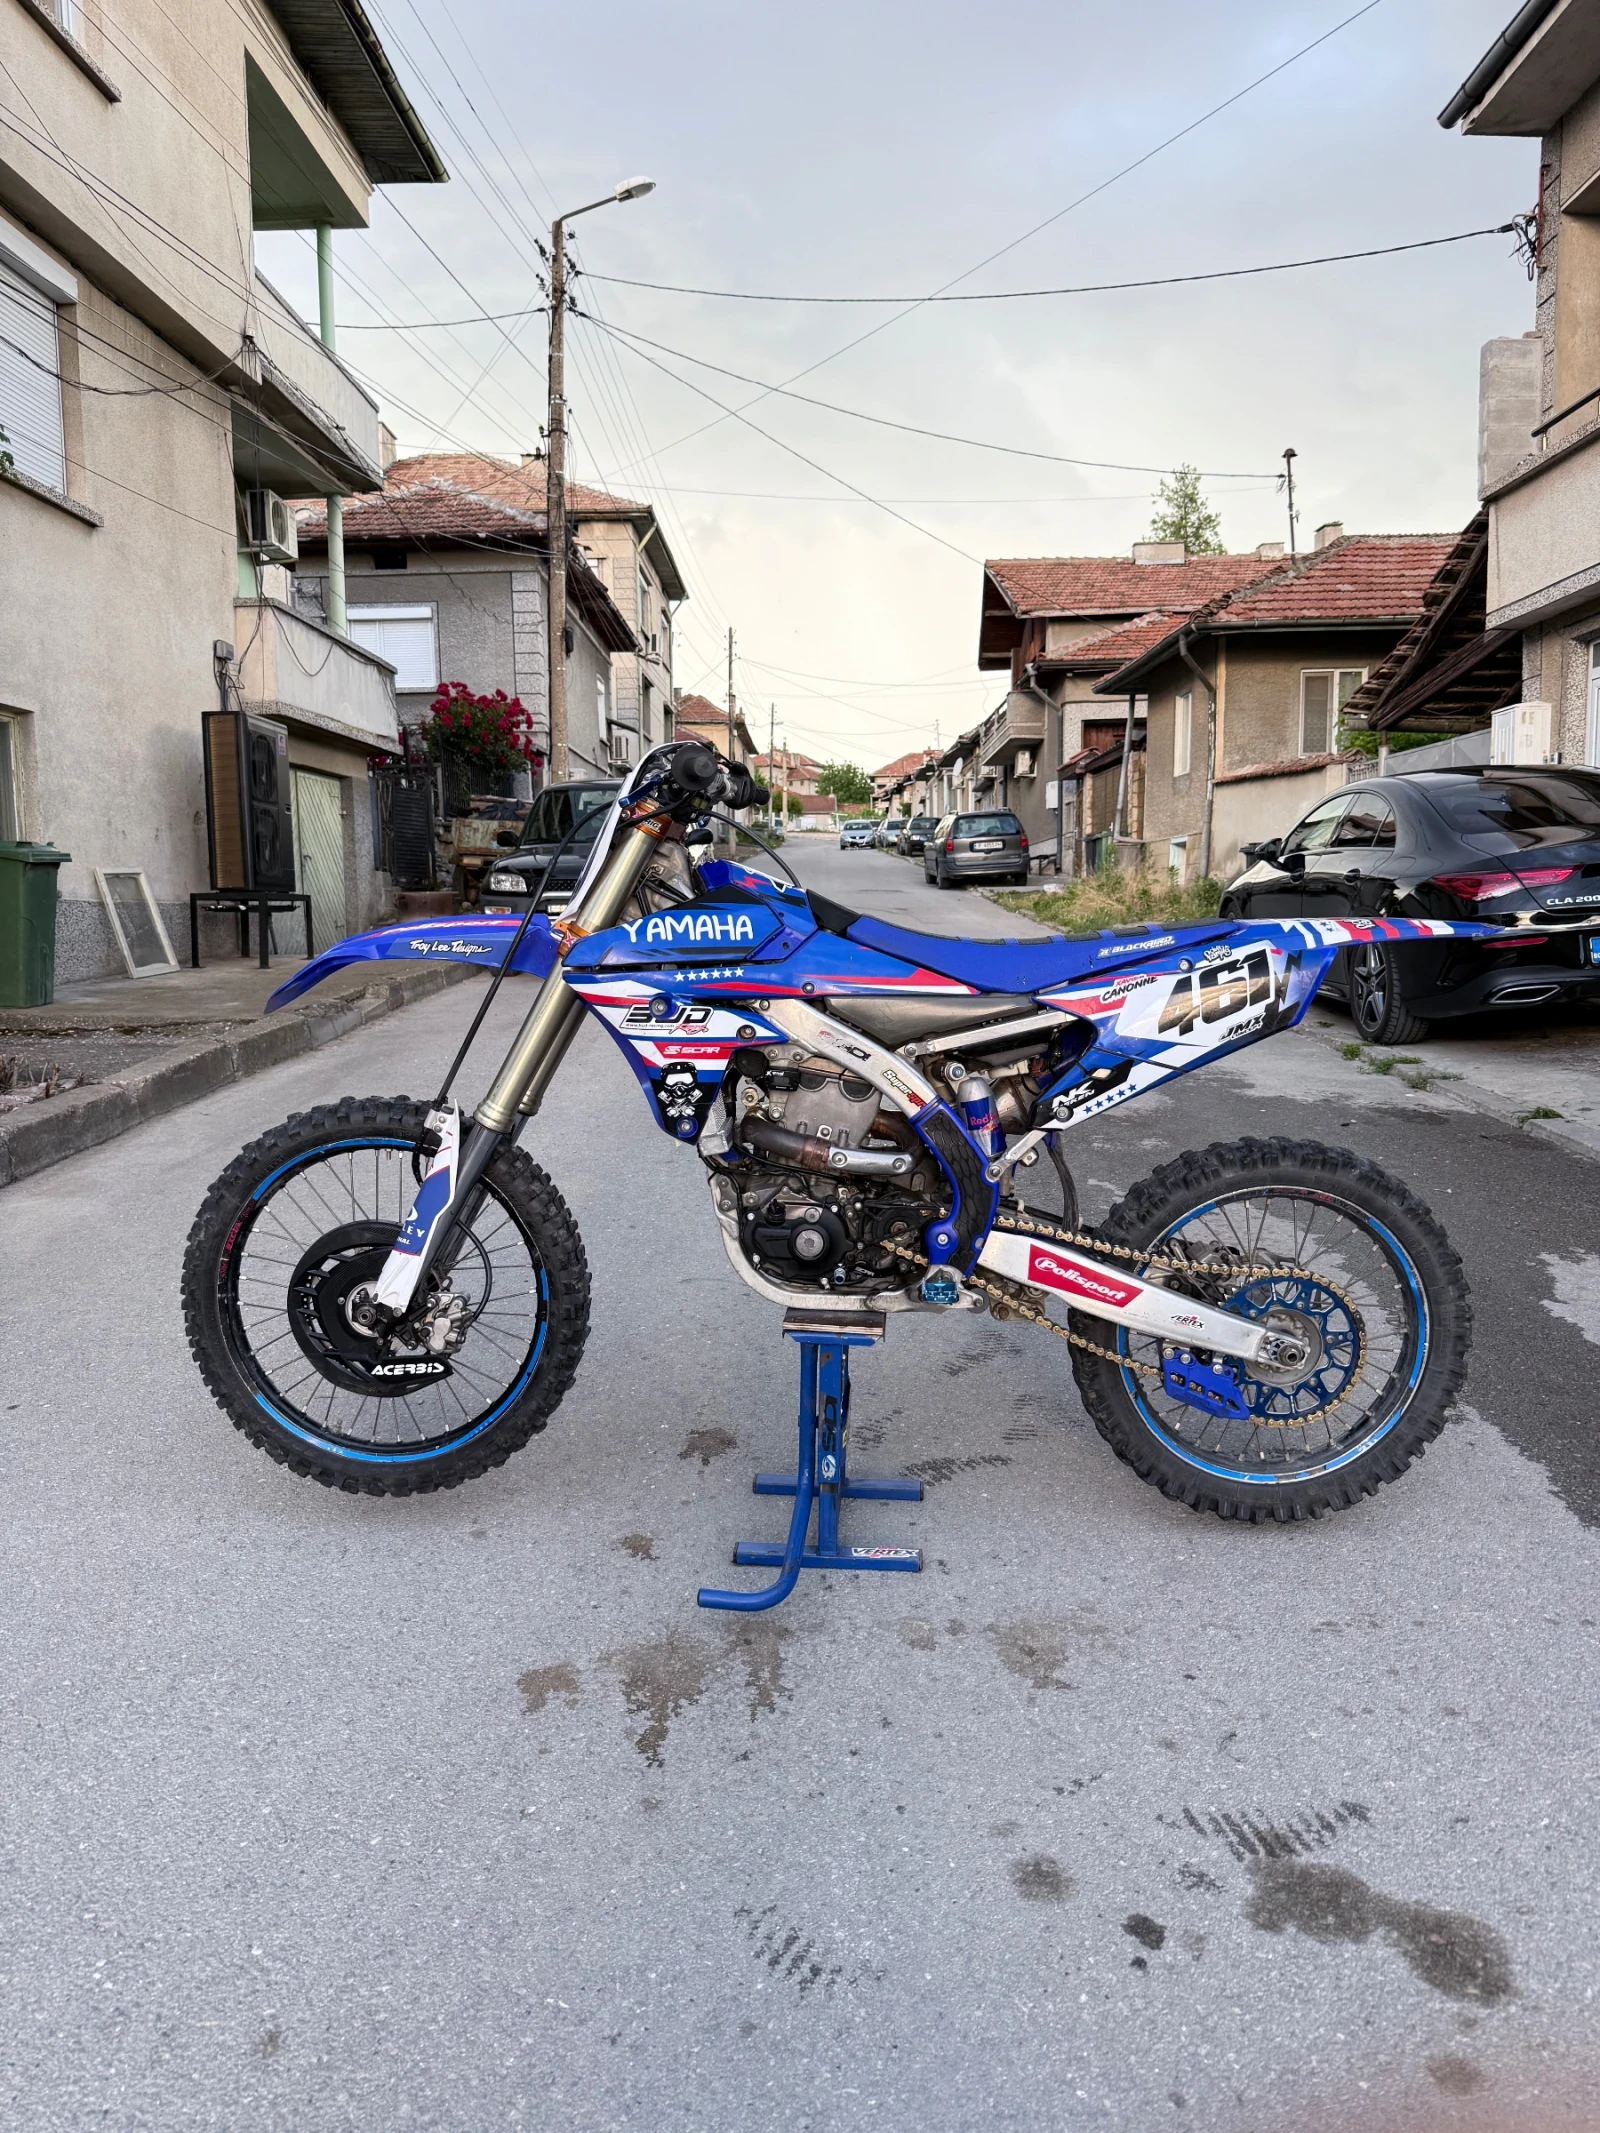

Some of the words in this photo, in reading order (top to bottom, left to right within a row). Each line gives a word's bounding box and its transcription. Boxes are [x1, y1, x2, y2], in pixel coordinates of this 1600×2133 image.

[1576, 895, 1600, 903] 200
[622, 914, 754, 943] YAMAHA
[409, 939, 430, 955] Troy
[431, 940, 450, 952] Lee
[450, 940, 492, 957] Designs
[1112, 936, 1173, 953] BLACKBIRD
[1102, 976, 1159, 1001] CANONNE
[1158, 949, 1271, 1036] 461
[681, 1046, 720, 1054] SCAR
[970, 1113, 989, 1125] Red
[1038, 1257, 1128, 1300] Polisport
[371, 1363, 445, 1376] ACERBIS
[852, 1548, 918, 1557] VERTEX
